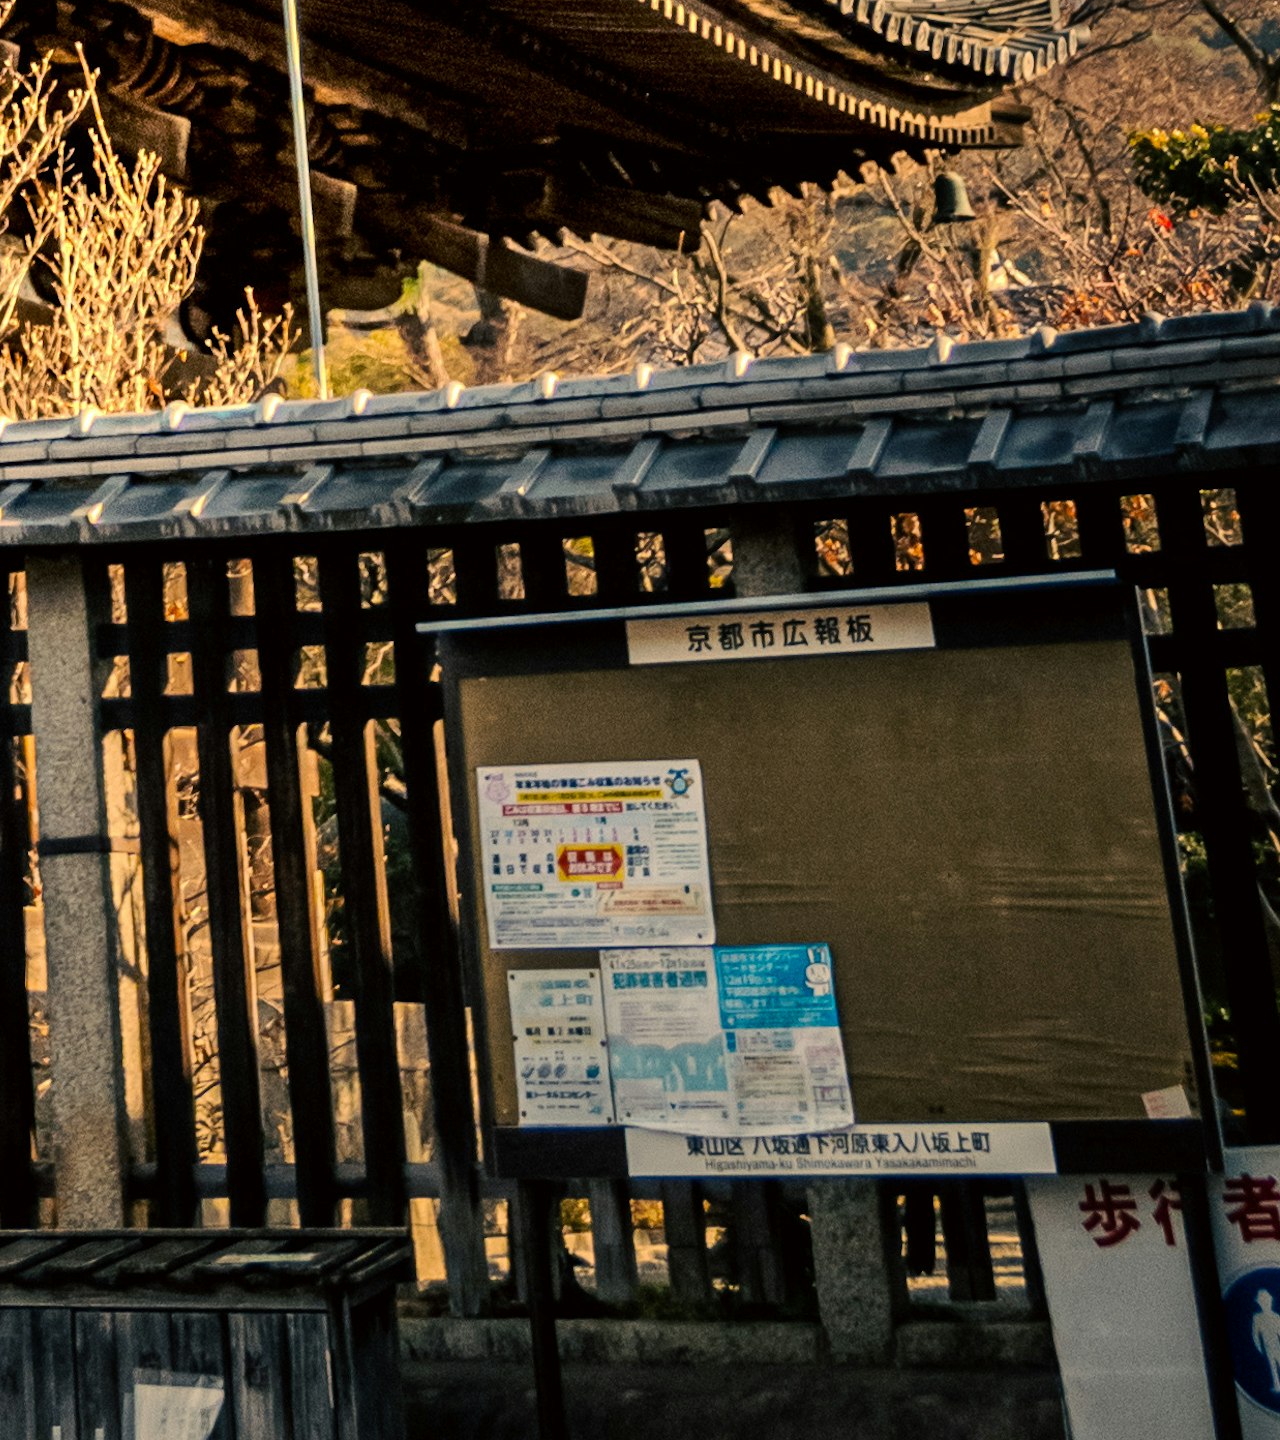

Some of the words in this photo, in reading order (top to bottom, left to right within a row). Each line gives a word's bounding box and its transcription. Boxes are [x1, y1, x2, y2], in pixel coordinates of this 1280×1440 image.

[685, 615, 876, 653] 京都市広報板
[704, 1158, 794, 1172] Higashiyama-ku
[795, 1157, 872, 1170] Shimokawara
